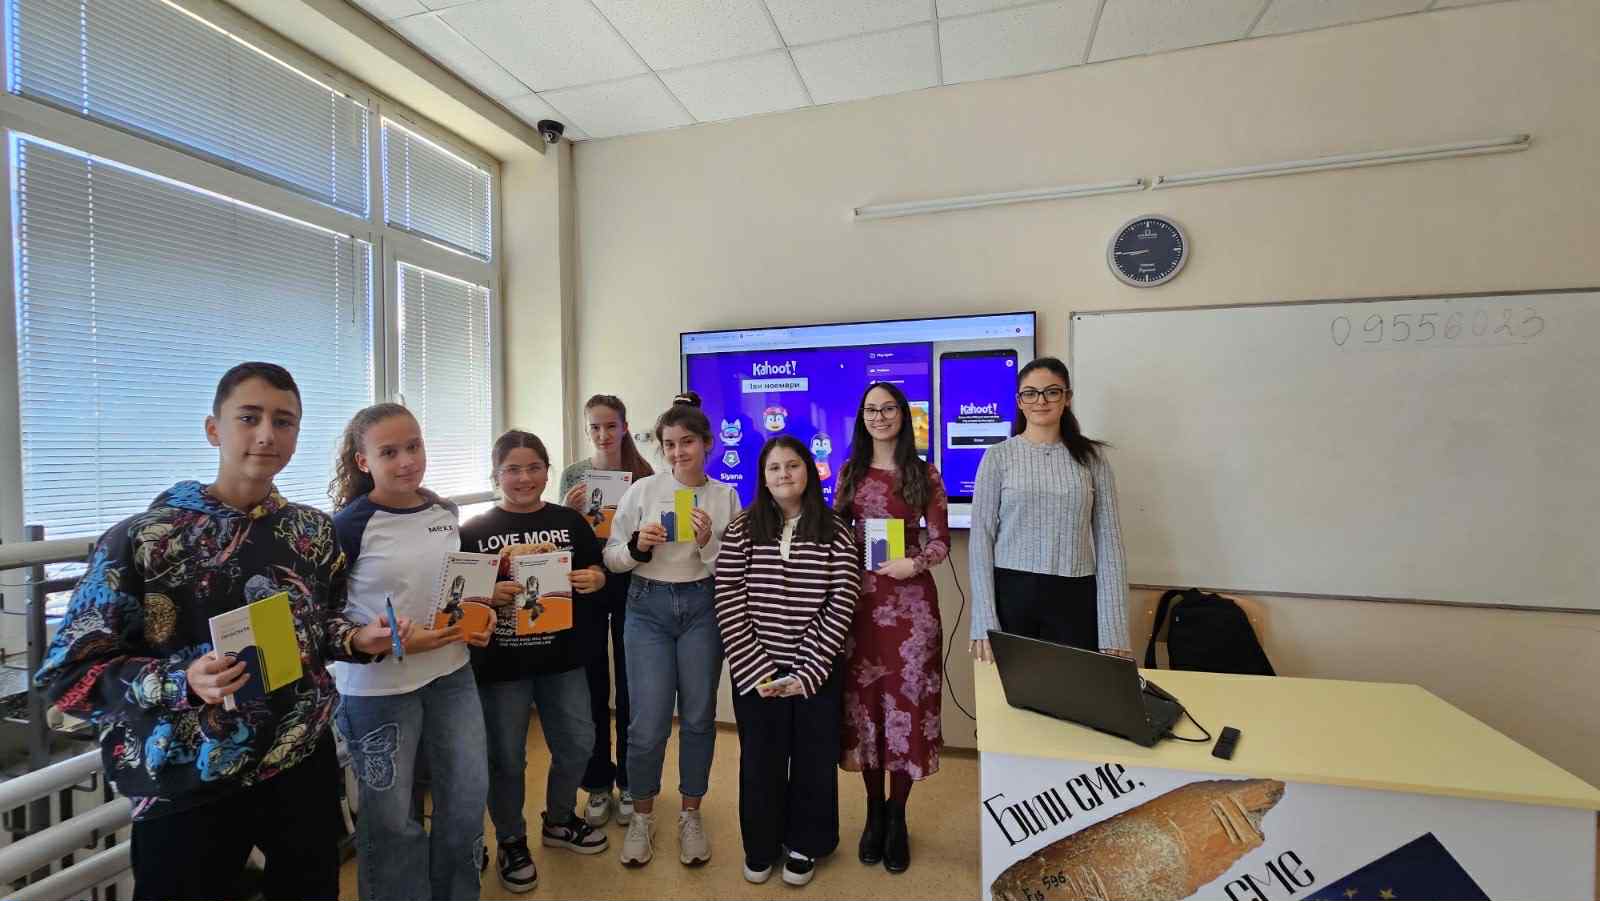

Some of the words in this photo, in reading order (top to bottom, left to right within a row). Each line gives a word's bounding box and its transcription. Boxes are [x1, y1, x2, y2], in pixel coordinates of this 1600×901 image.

[752, 360, 797, 376] Kahoot!
[960, 402, 998, 415] Kahoot!
[727, 453, 735, 463] 2
[478, 533, 520, 553] LOVE
[524, 529, 570, 545] MORE
[983, 788, 1073, 847] Били
